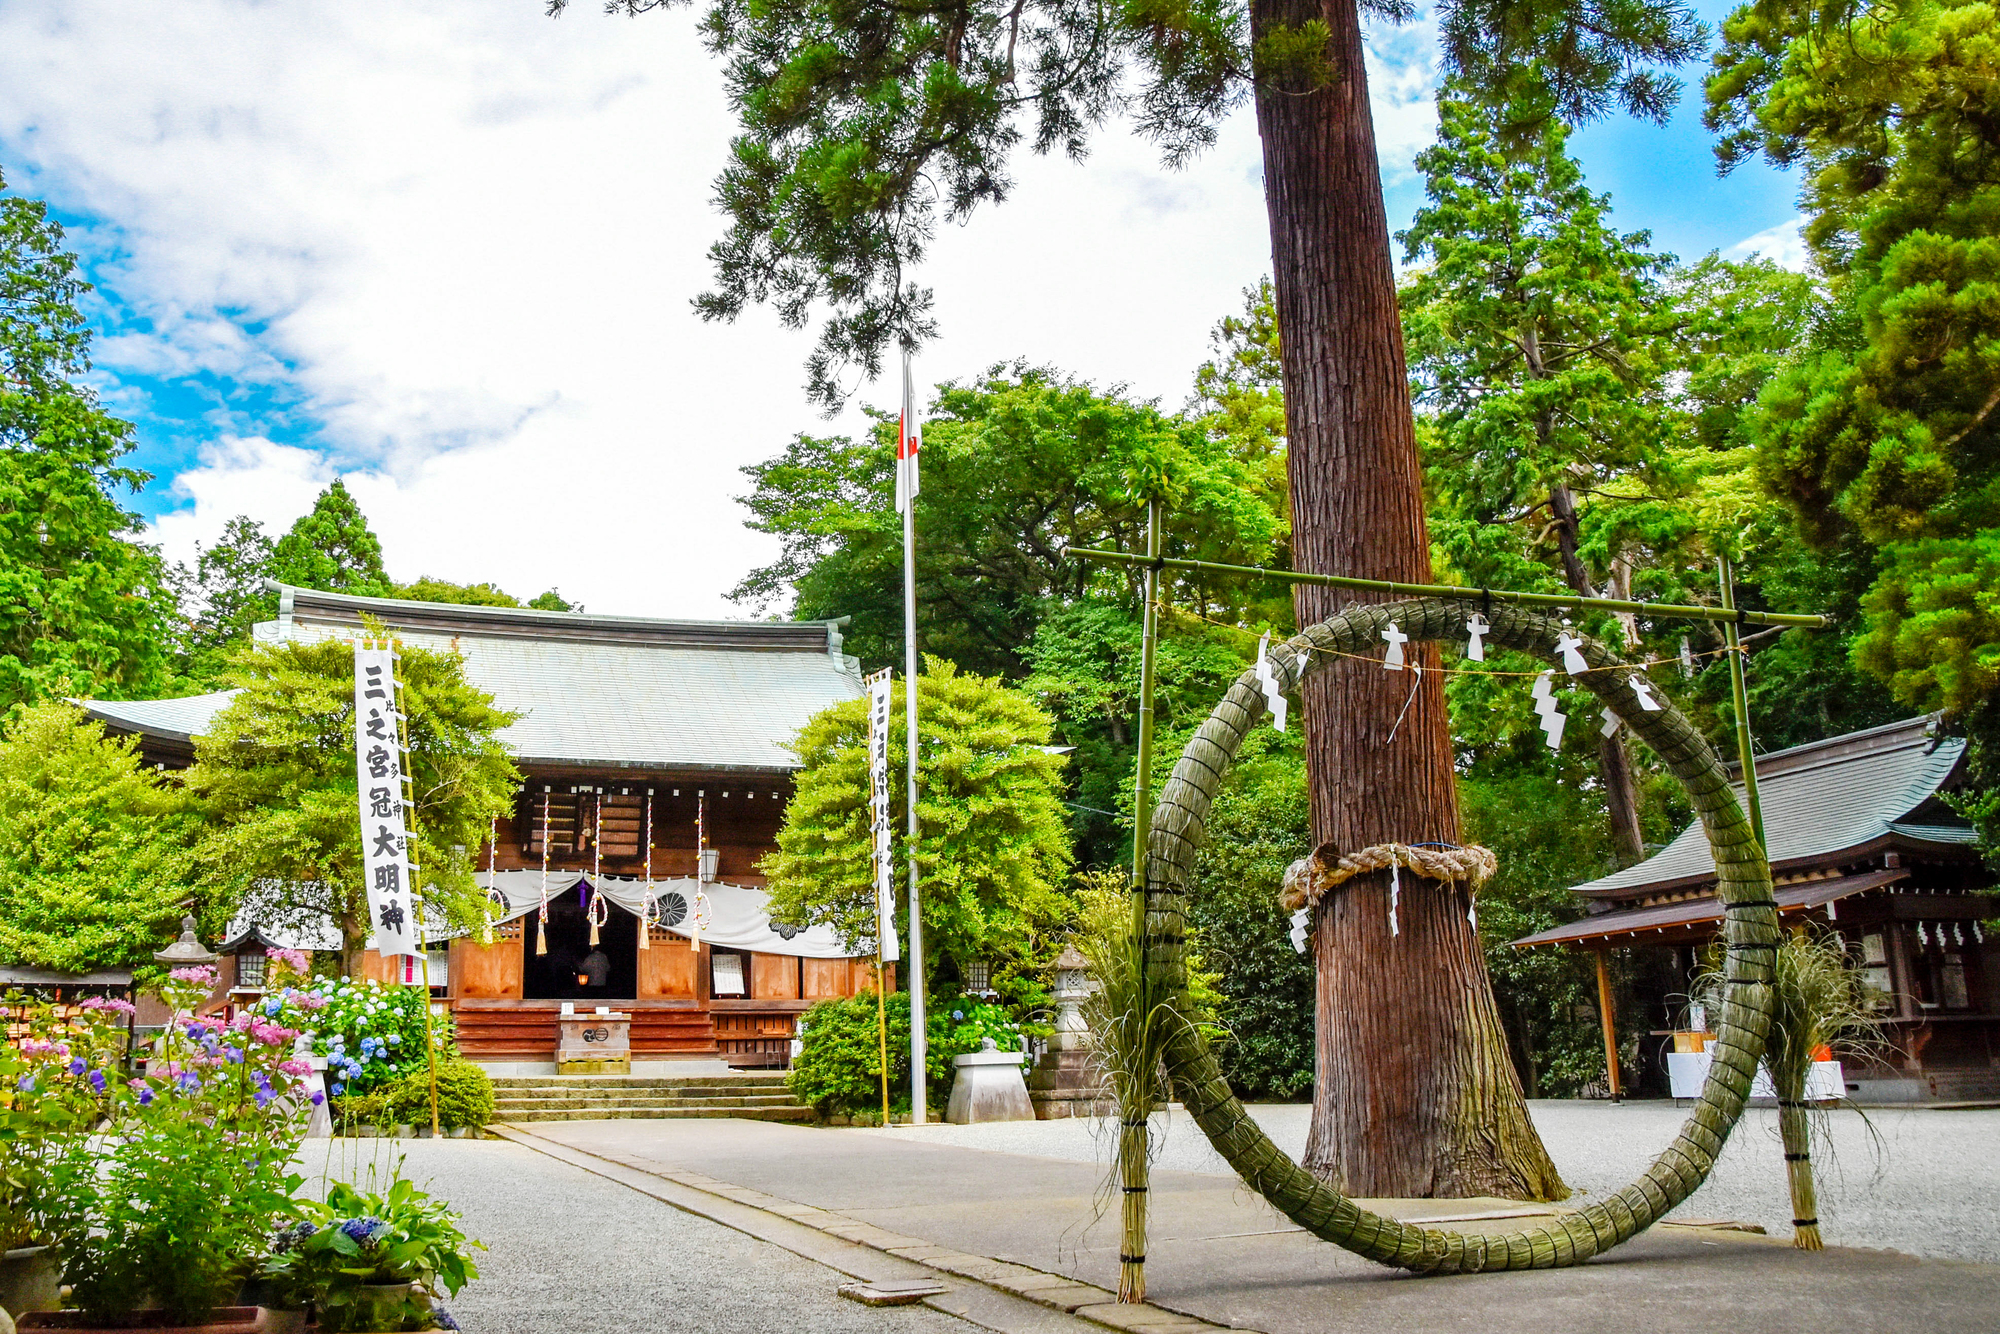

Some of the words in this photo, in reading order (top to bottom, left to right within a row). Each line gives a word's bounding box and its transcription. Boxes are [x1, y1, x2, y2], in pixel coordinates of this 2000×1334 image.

[364, 665, 404, 935] 三之宮冠大明神
[385, 700, 405, 850] 比々多神社
